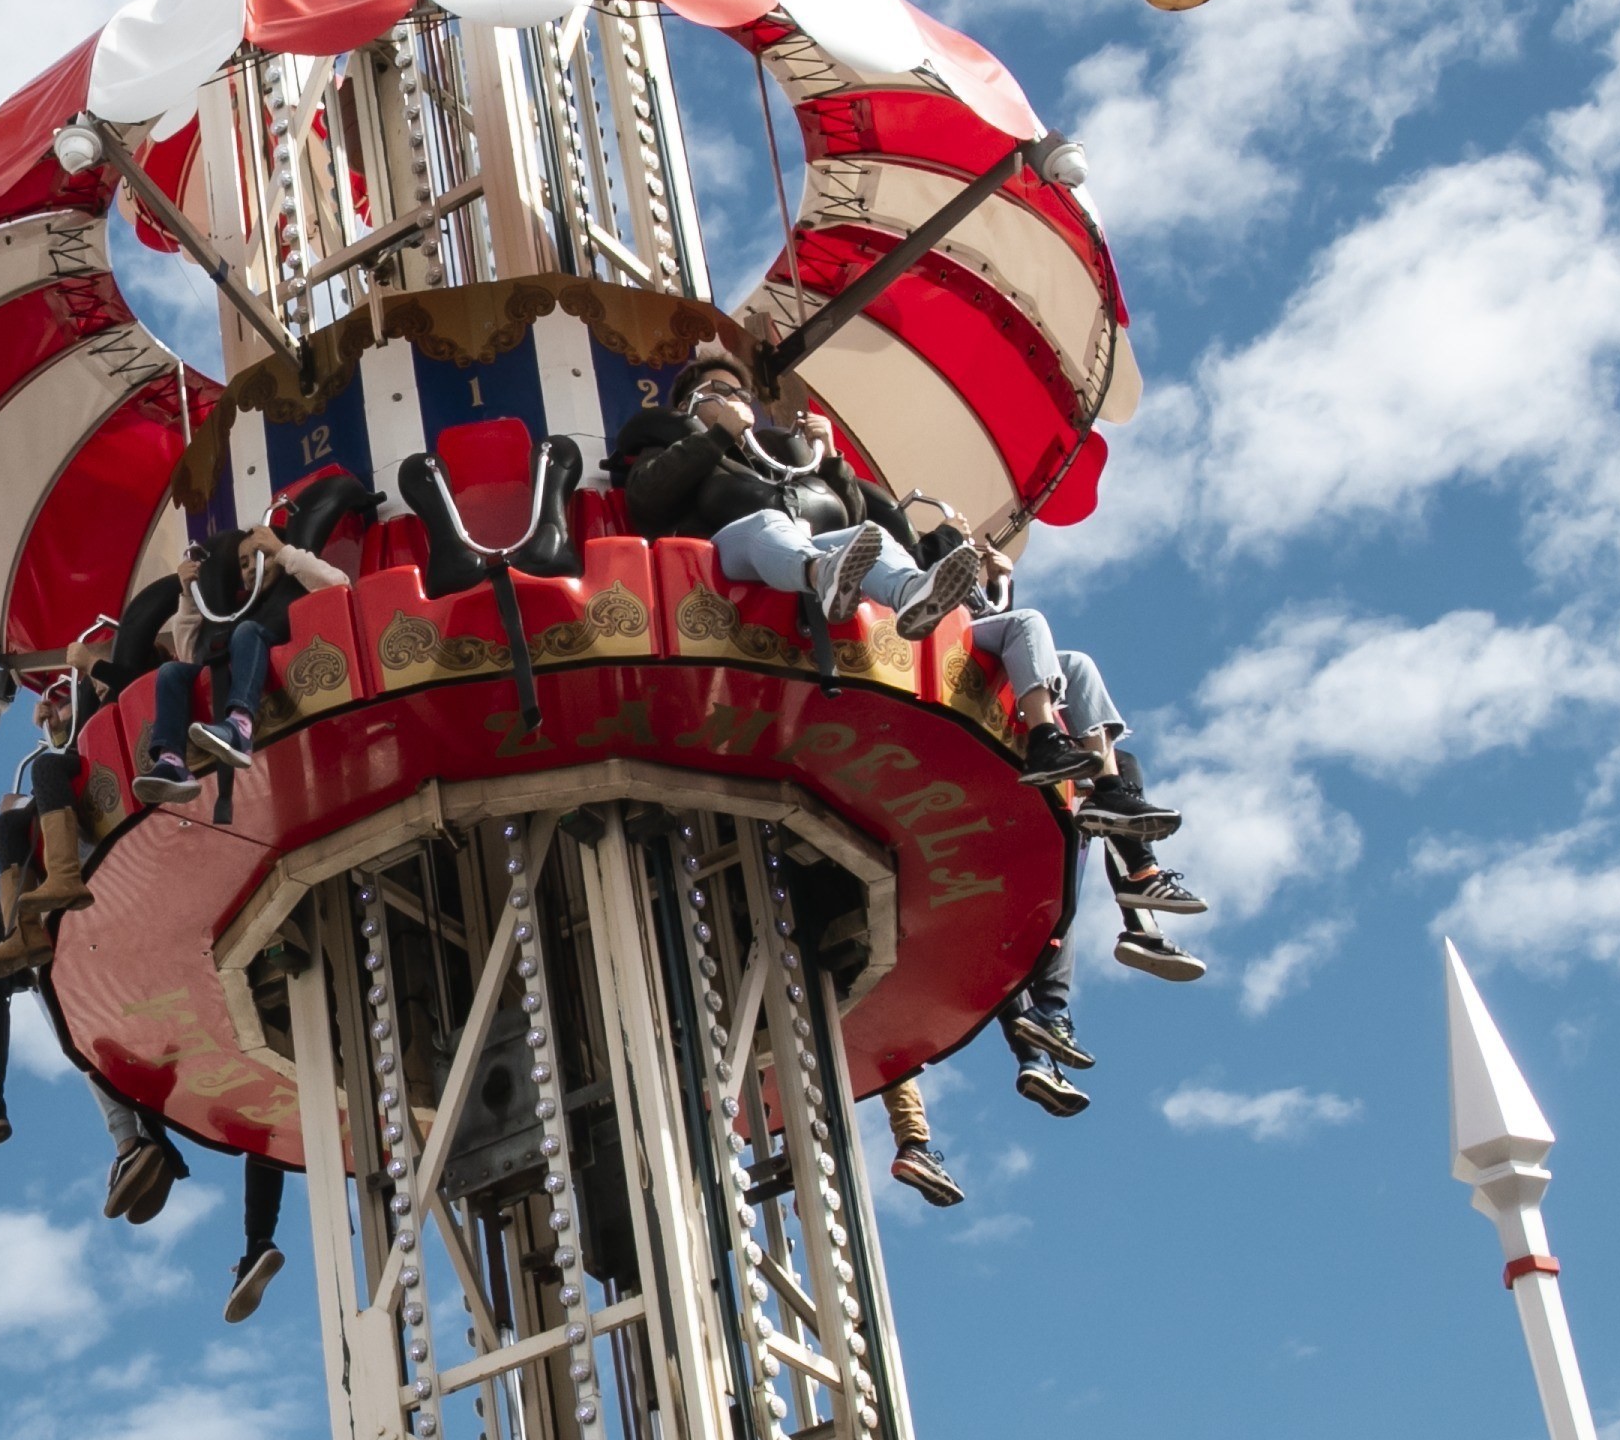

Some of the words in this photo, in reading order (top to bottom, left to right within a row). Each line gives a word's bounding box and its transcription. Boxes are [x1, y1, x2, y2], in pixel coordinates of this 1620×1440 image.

[468, 376, 485, 407] 1
[636, 378, 660, 409] 2
[301, 425, 334, 466] 12
[482, 700, 1006, 911] ZAMPERLA
